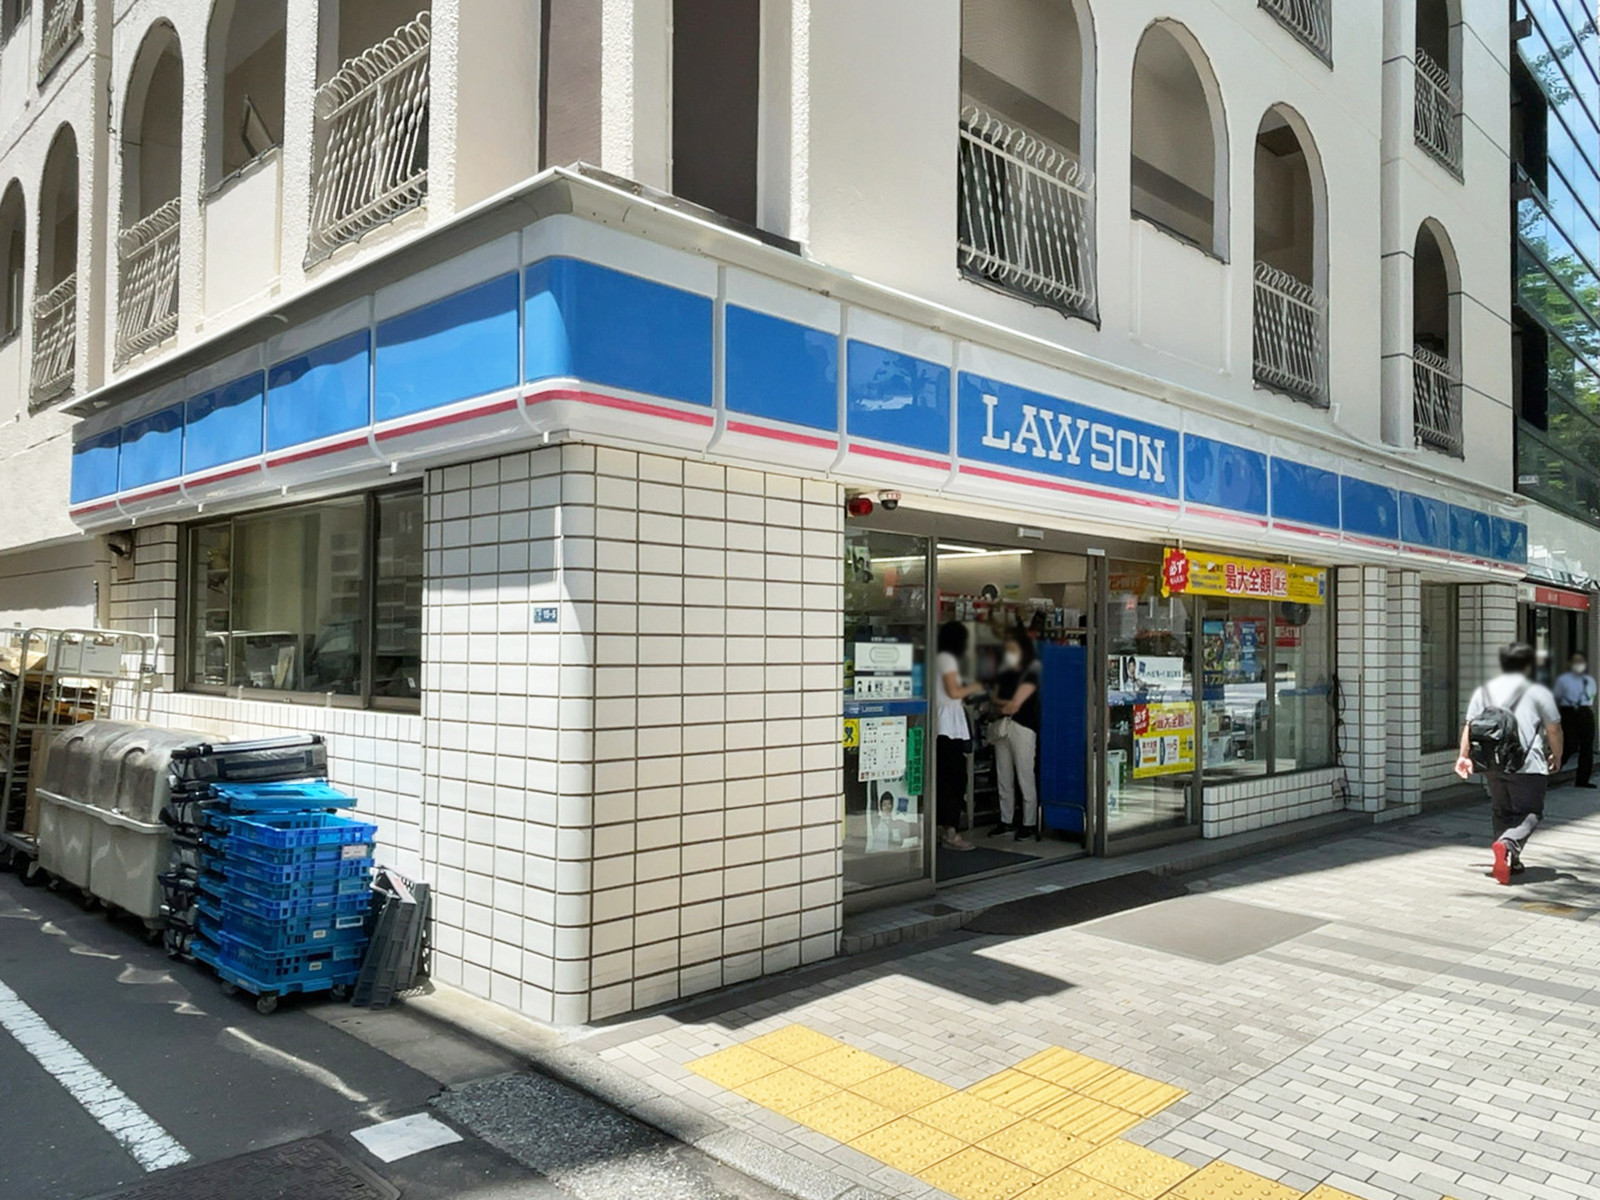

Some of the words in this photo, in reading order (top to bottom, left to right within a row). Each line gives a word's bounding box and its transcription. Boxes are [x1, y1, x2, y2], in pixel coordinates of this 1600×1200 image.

[981, 393, 1166, 483] LAWSON
[1169, 559, 1186, 576] 必ず
[1225, 564, 1271, 593] 最大全額
